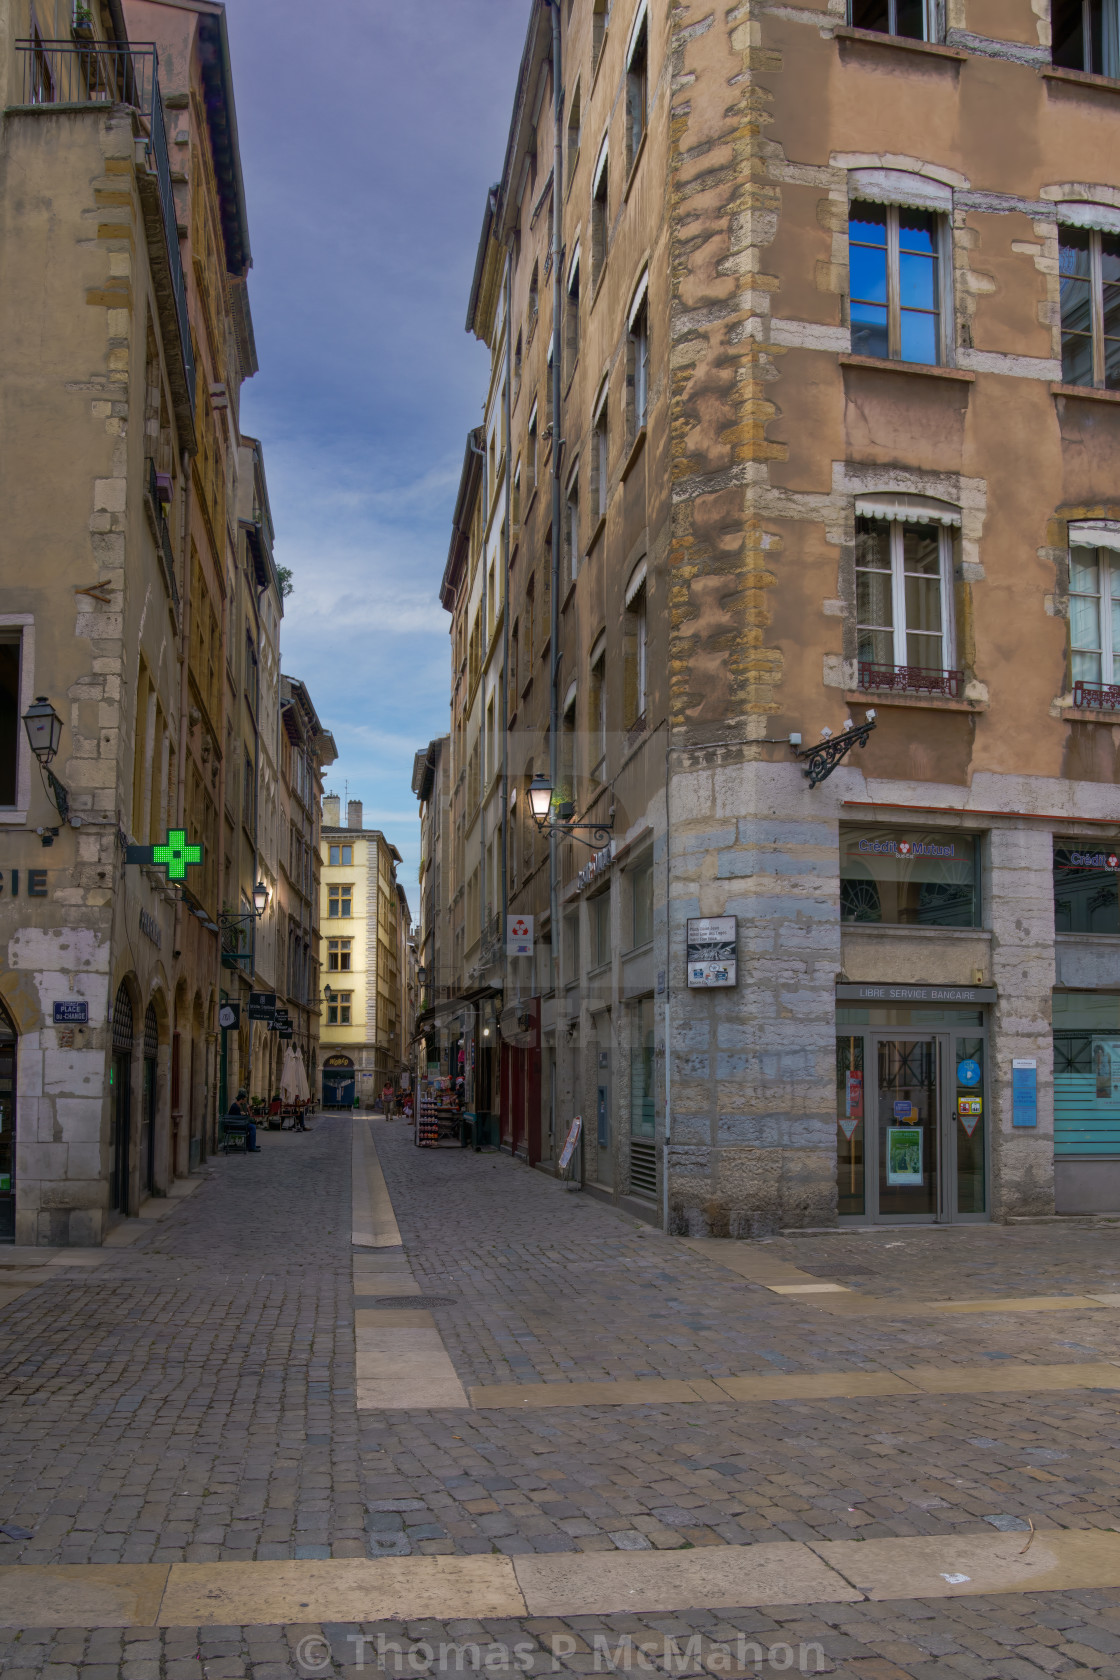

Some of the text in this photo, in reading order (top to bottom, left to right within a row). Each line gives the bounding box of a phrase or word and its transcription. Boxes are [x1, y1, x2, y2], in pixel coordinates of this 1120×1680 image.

[859, 839, 954, 857] Crédit Mutuel
[1071, 852, 1108, 867] Crédit
[0, 869, 48, 896] IE
[859, 988, 976, 1001] LIBRE SERVICE BANCAIRE
